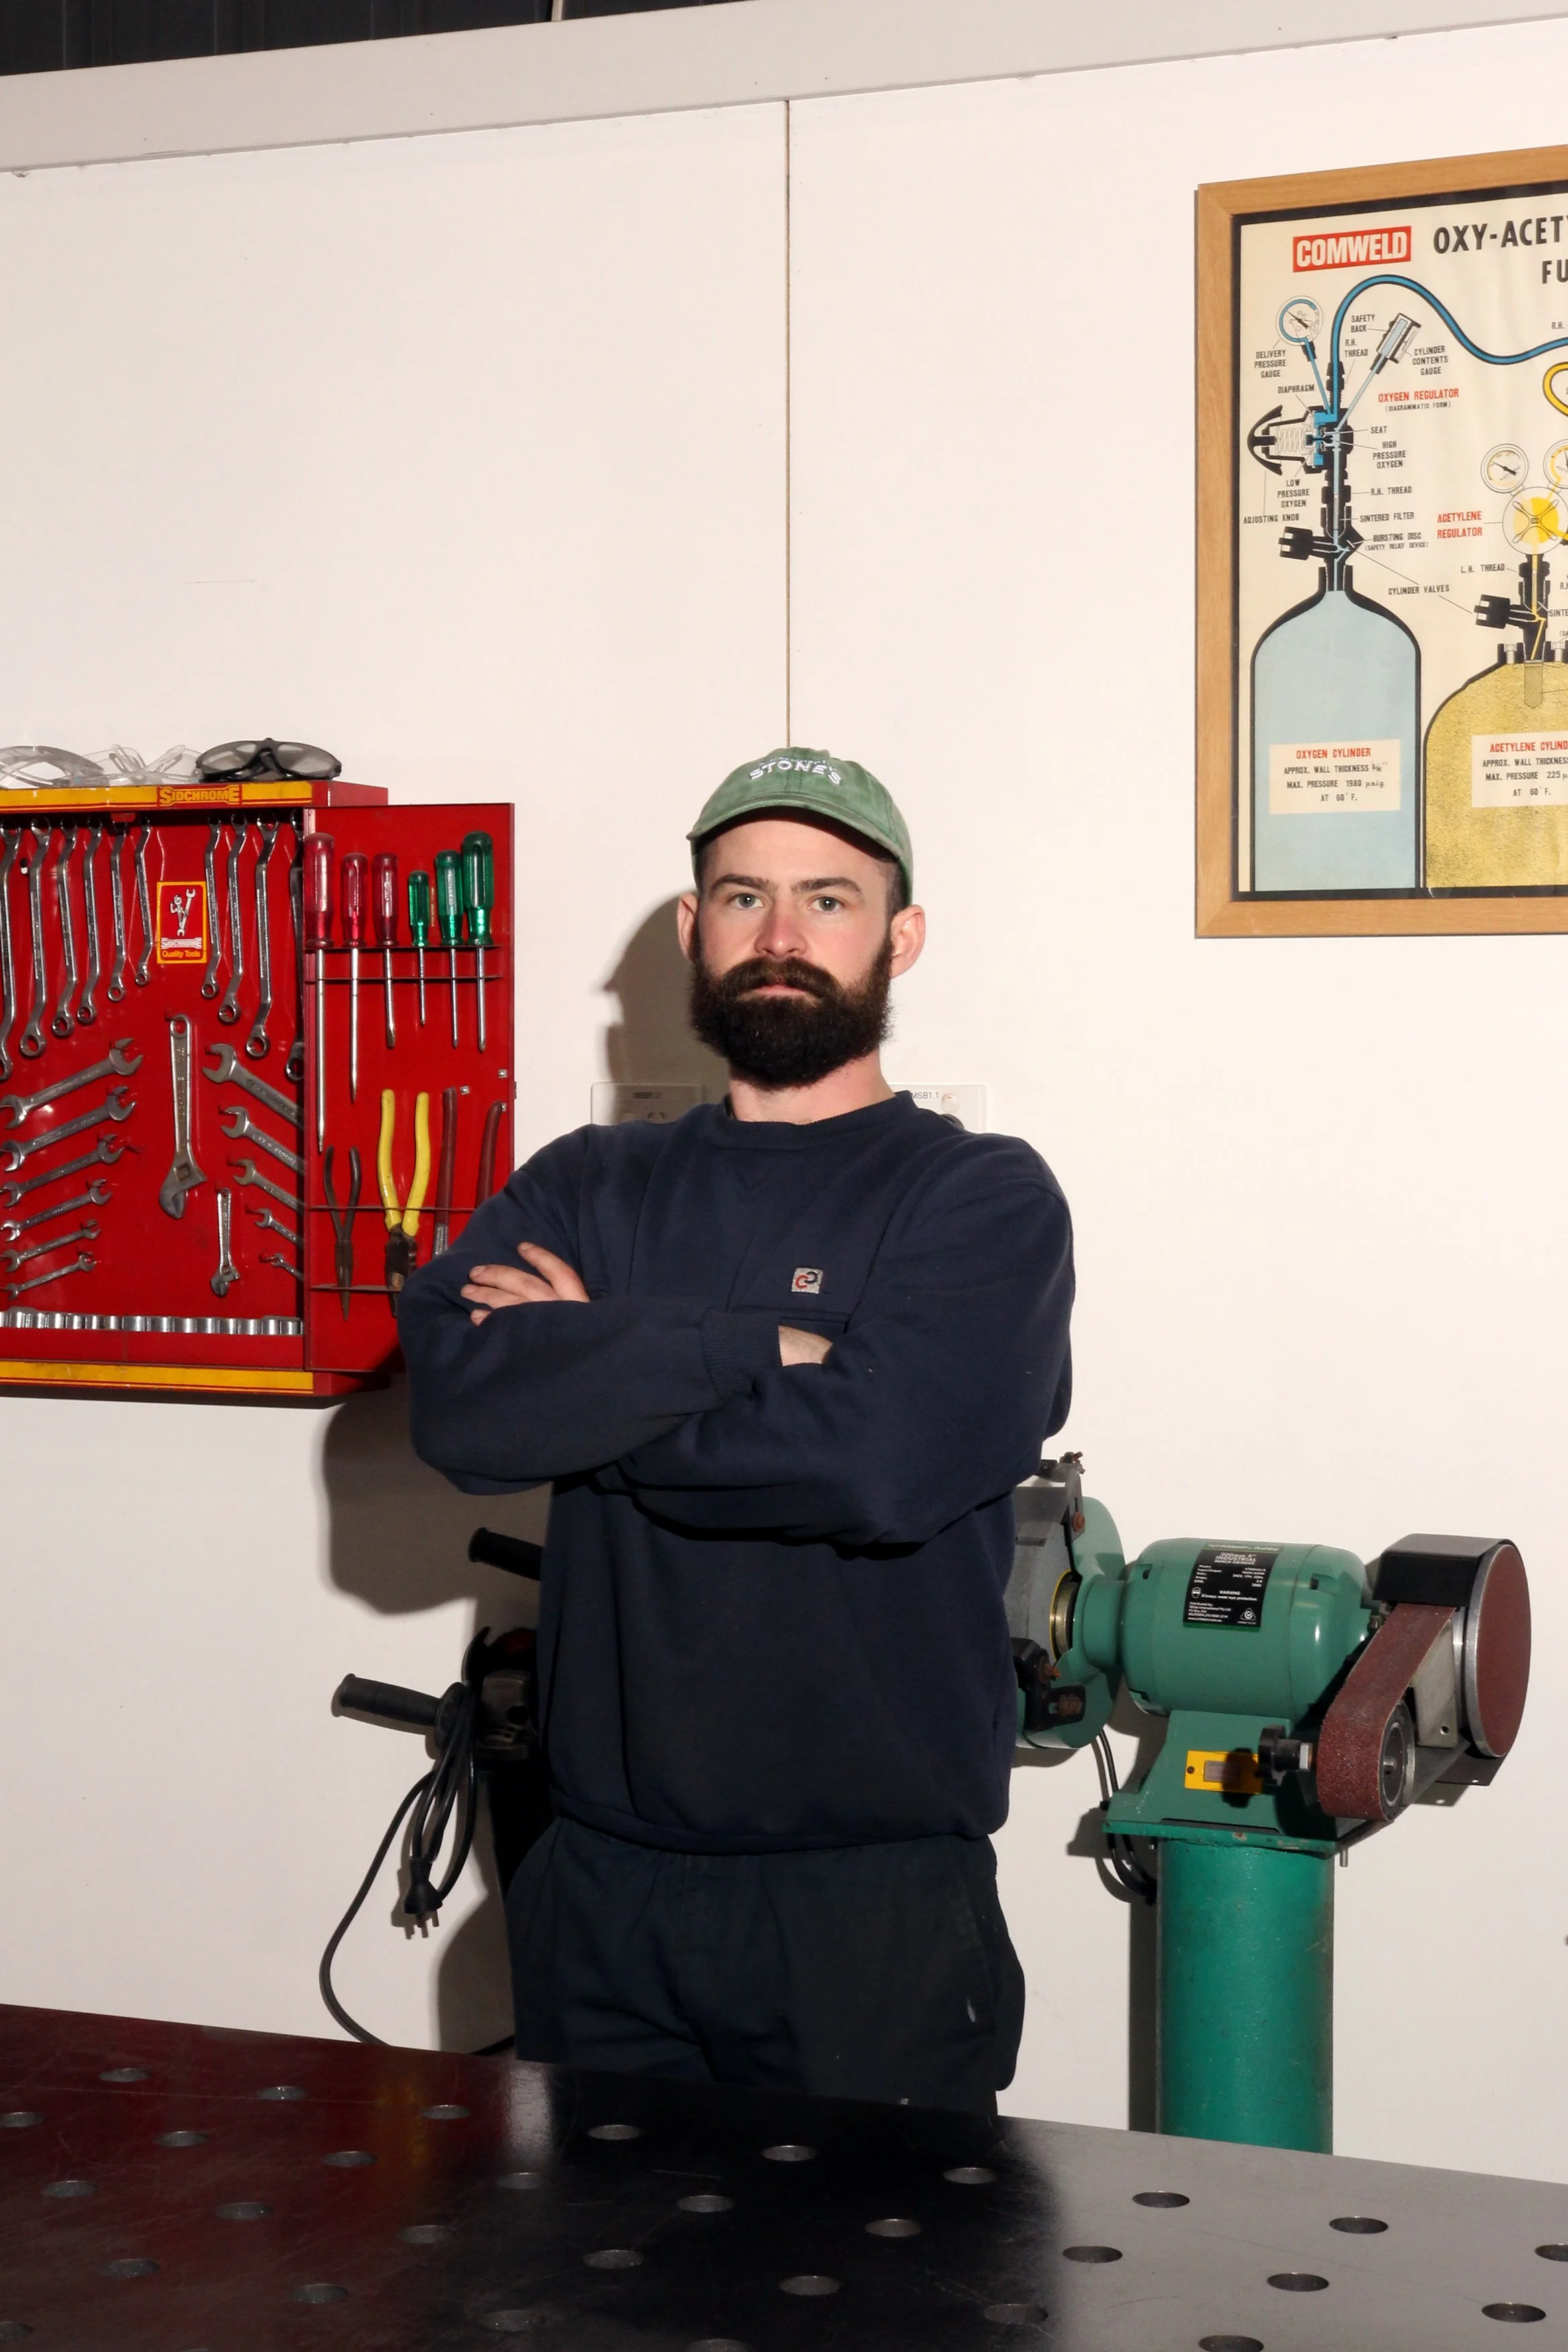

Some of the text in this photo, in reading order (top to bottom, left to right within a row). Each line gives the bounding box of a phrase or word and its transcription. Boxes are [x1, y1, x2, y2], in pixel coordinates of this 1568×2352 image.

[1433, 215, 1568, 254] OXY-ACET
[1296, 231, 1407, 268] COMWELD
[1351, 314, 1375, 322] SAFETY
[1351, 325, 1367, 333] BACK
[1551, 321, 1565, 329] R.H.
[1256, 349, 1286, 359] DELIVERY
[1345, 349, 1368, 357] THREAD
[1414, 345, 1445, 356] CYLINDER
[1254, 359, 1286, 369] PRESSURE
[1412, 355, 1448, 365] CONTENTS
[1261, 369, 1280, 378] GAUGE
[1421, 367, 1441, 375] GAUGE
[1278, 384, 1315, 394] DIAPHRAGM
[1378, 388, 1459, 402] OXYGEN REGULATOR
[1386, 401, 1451, 412] (DIAGRAMMATIC FORM)
[1370, 426, 1388, 434] SEAT
[1382, 440, 1396, 449] HIGH
[1373, 451, 1406, 460] PRESSURE
[1377, 460, 1403, 469] OXYGEN
[1286, 479, 1301, 487] LOW
[1277, 489, 1310, 498] PRESSURE
[1388, 486, 1412, 495] THREAD
[1281, 499, 1307, 508] OXYGEN
[1244, 515, 1278, 524] ADJUSTING
[1360, 512, 1414, 522] SINTERED FILTER
[1437, 511, 1482, 523] ACETYLENE
[1373, 533, 1403, 542] BURSTING
[1437, 527, 1482, 539] REGULATOR
[1480, 563, 1505, 572] THREAD
[1388, 584, 1450, 595] CYLINDER VALVES
[1490, 742, 1536, 752] ACETYLENE
[1296, 748, 1371, 760] OXYGEN CYLINDER
[1482, 758, 1510, 767] APPROX.
[1514, 758, 1532, 766] WALL
[1284, 766, 1311, 774] APPROX.
[1314, 766, 1330, 774] WALL
[1335, 764, 1369, 773] THICKNESS
[1486, 772, 1503, 781] MAX.
[1506, 771, 1539, 780] PRESSURE
[1547, 770, 1561, 779] 225
[1287, 780, 1303, 788] MAX.
[1307, 779, 1338, 788] PRESSURE
[1345, 779, 1362, 787] 1980
[160, 786, 239, 804] SIDCHROME
[1512, 788, 1522, 797] AT
[1321, 794, 1329, 802] AT
[162, 949, 200, 959] Quality Tools
